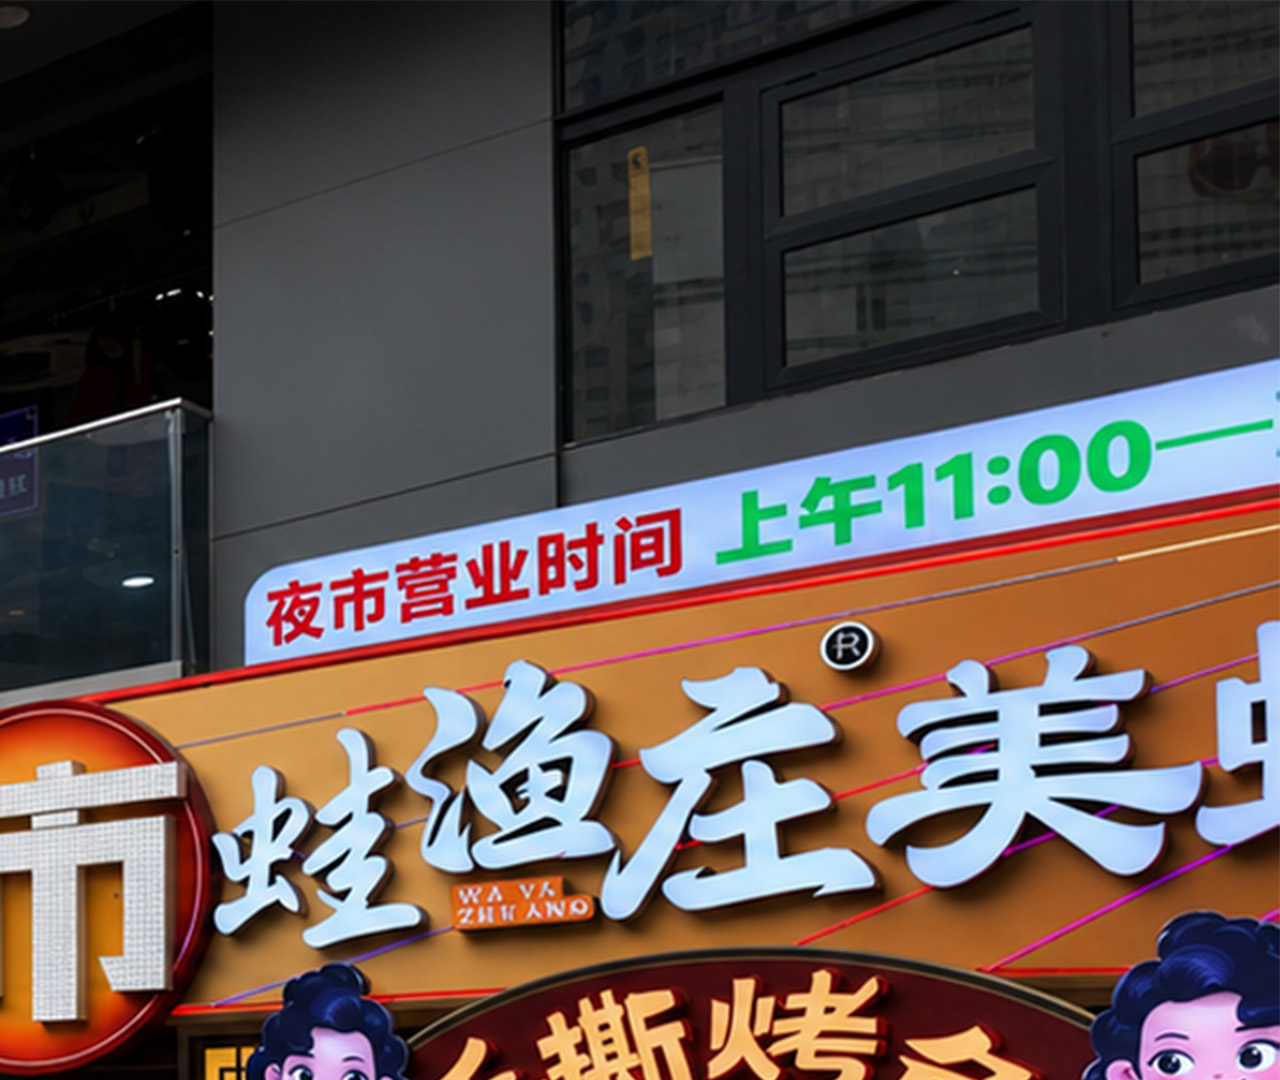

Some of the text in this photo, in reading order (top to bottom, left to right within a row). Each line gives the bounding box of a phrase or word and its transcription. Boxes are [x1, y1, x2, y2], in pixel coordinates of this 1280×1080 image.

[264, 507, 683, 647] 夜市营业时间
